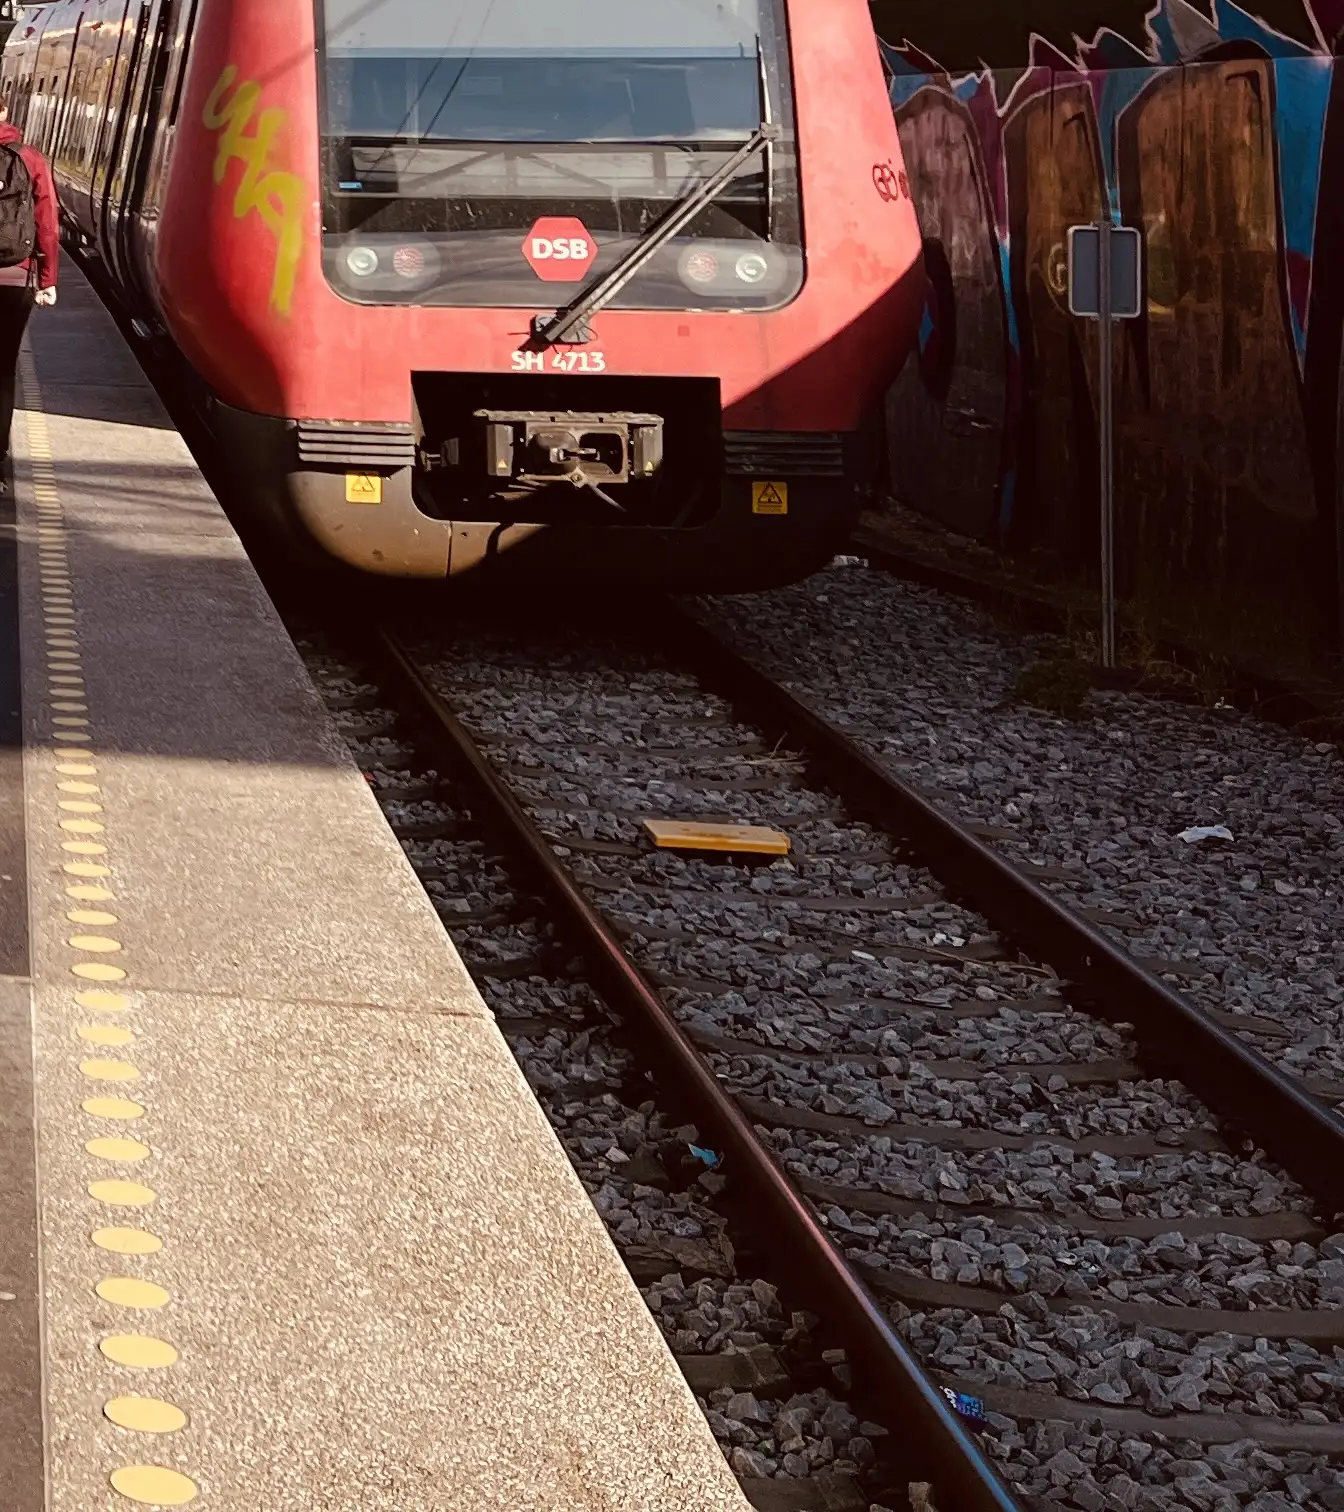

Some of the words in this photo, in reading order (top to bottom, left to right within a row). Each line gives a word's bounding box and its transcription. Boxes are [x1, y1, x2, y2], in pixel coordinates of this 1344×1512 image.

[531, 238, 588, 260] DSB
[510, 350, 545, 372] SH
[551, 351, 606, 372] 4713
